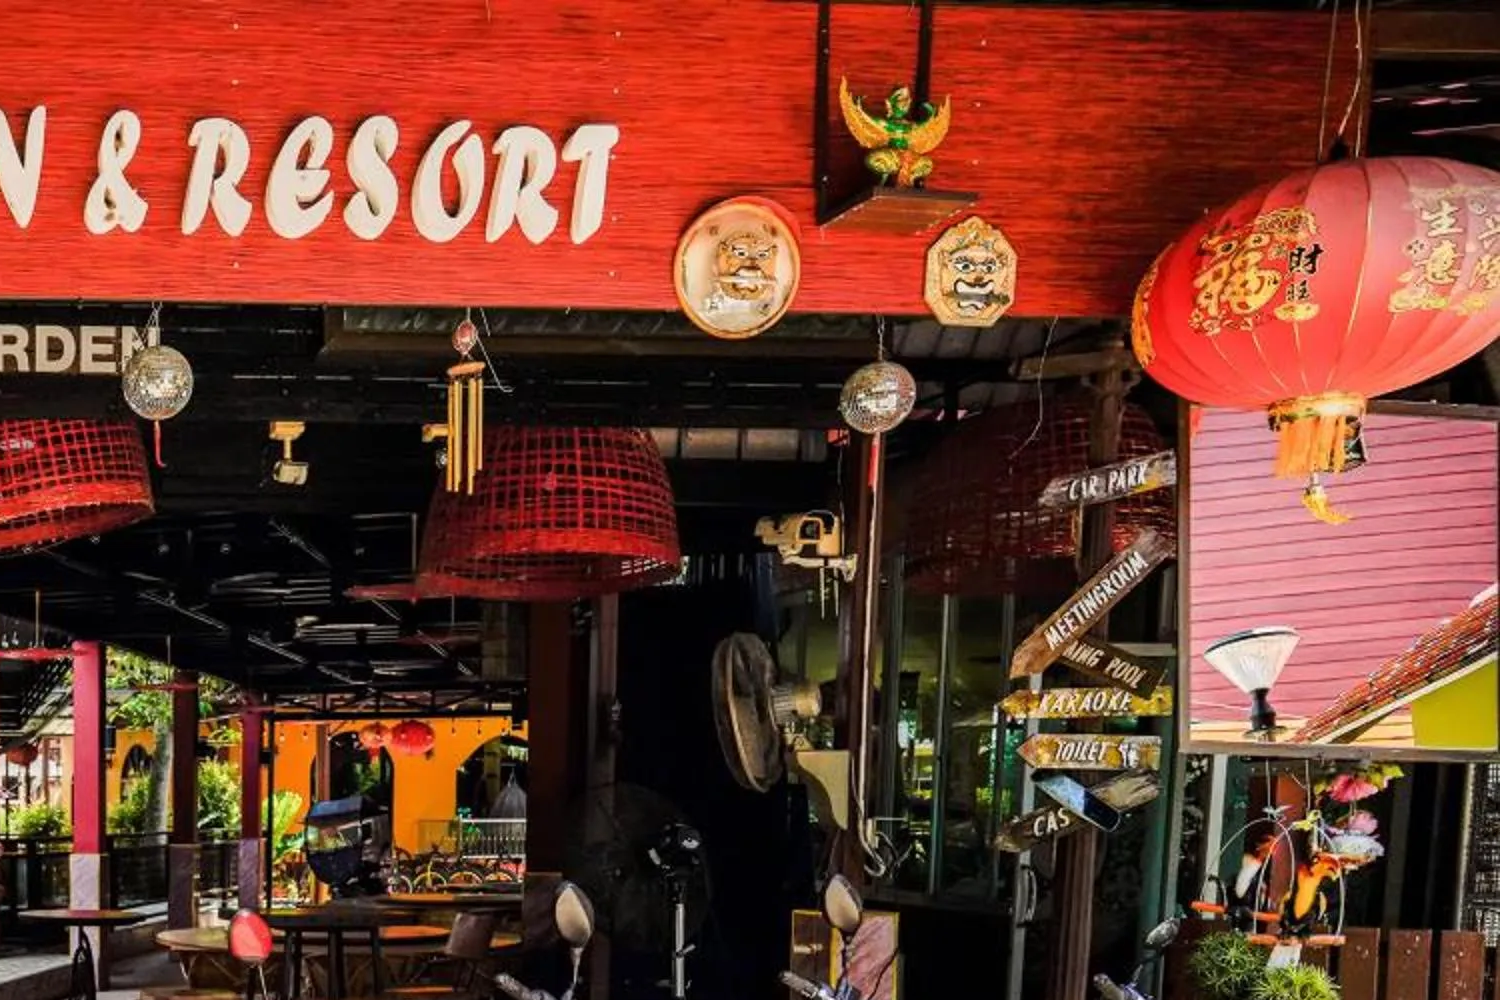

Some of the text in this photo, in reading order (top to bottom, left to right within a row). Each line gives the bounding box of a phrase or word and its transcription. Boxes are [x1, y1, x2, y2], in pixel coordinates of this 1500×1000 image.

[83, 110, 148, 235] &
[181, 115, 620, 245] RESORT
[1068, 462, 1149, 501] CAR PARK
[1043, 550, 1150, 652] MEETINGROOM
[1102, 655, 1147, 689] POOL
[1038, 691, 1133, 713] KARAOKE
[1055, 740, 1111, 762] TOILET
